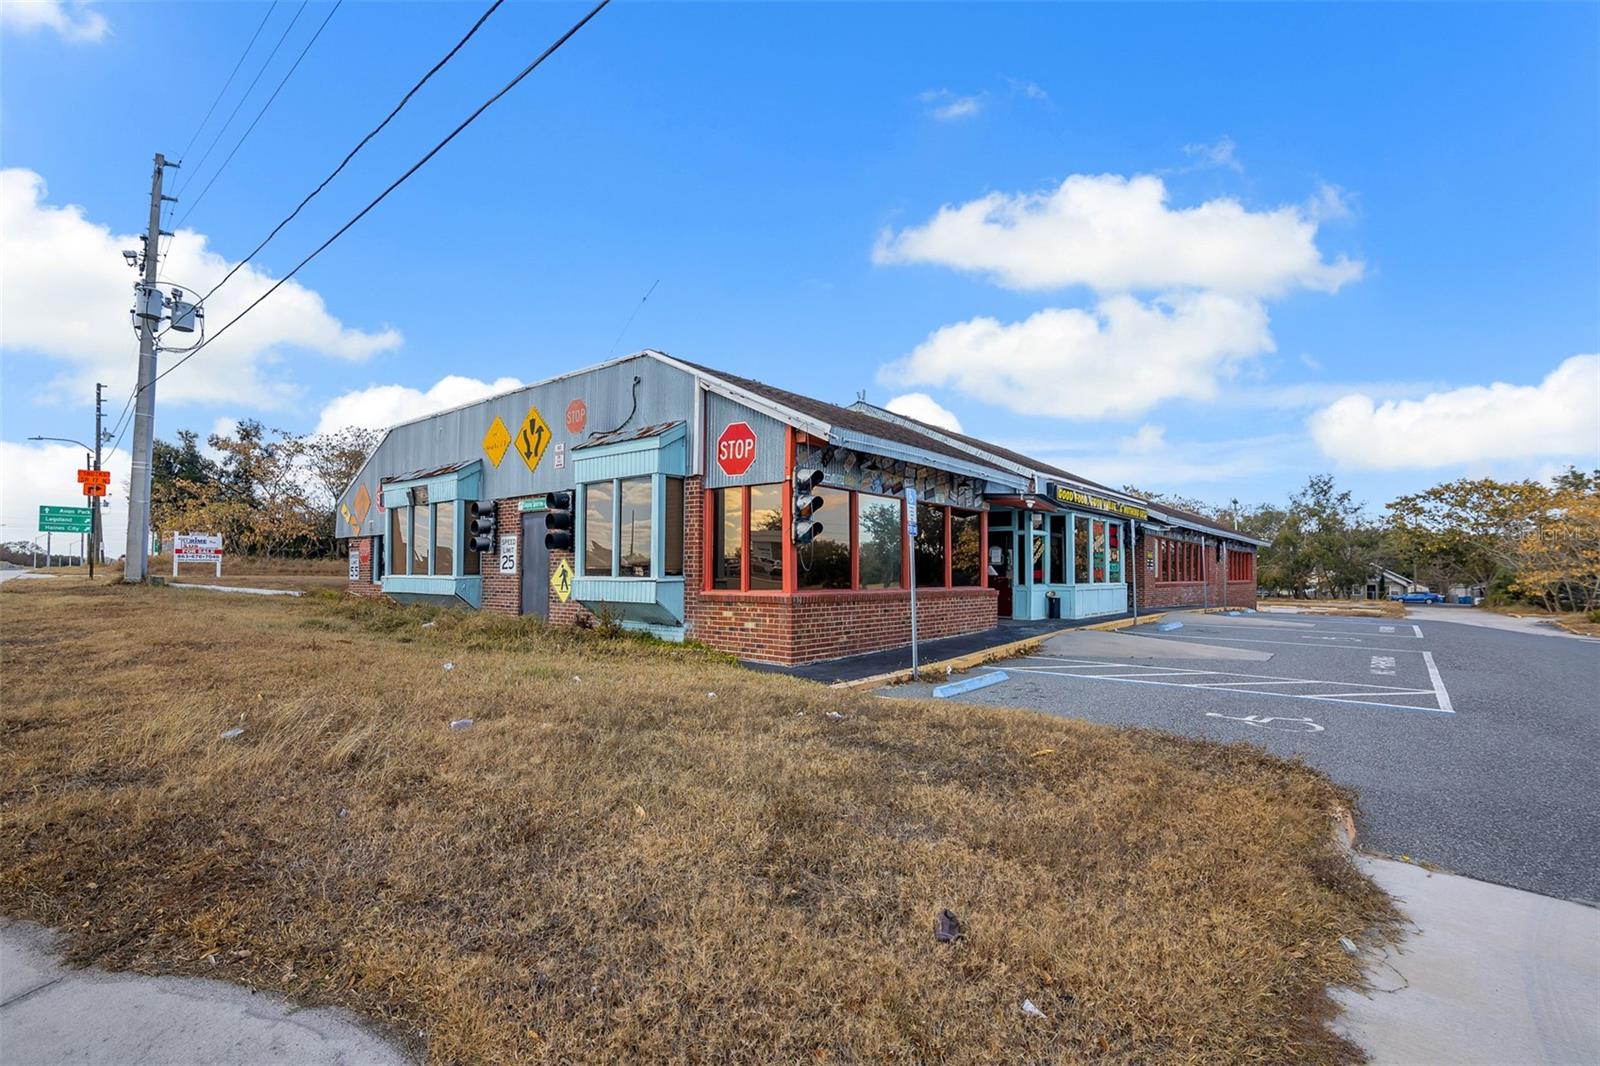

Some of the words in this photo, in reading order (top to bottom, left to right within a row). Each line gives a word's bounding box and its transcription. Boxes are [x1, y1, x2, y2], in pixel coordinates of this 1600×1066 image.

[567, 409, 585, 425] STOP
[720, 439, 754, 460] STOP
[1058, 489, 1073, 501] GOOD
[501, 555, 515, 570] 25
[350, 566, 359, 577] 55
